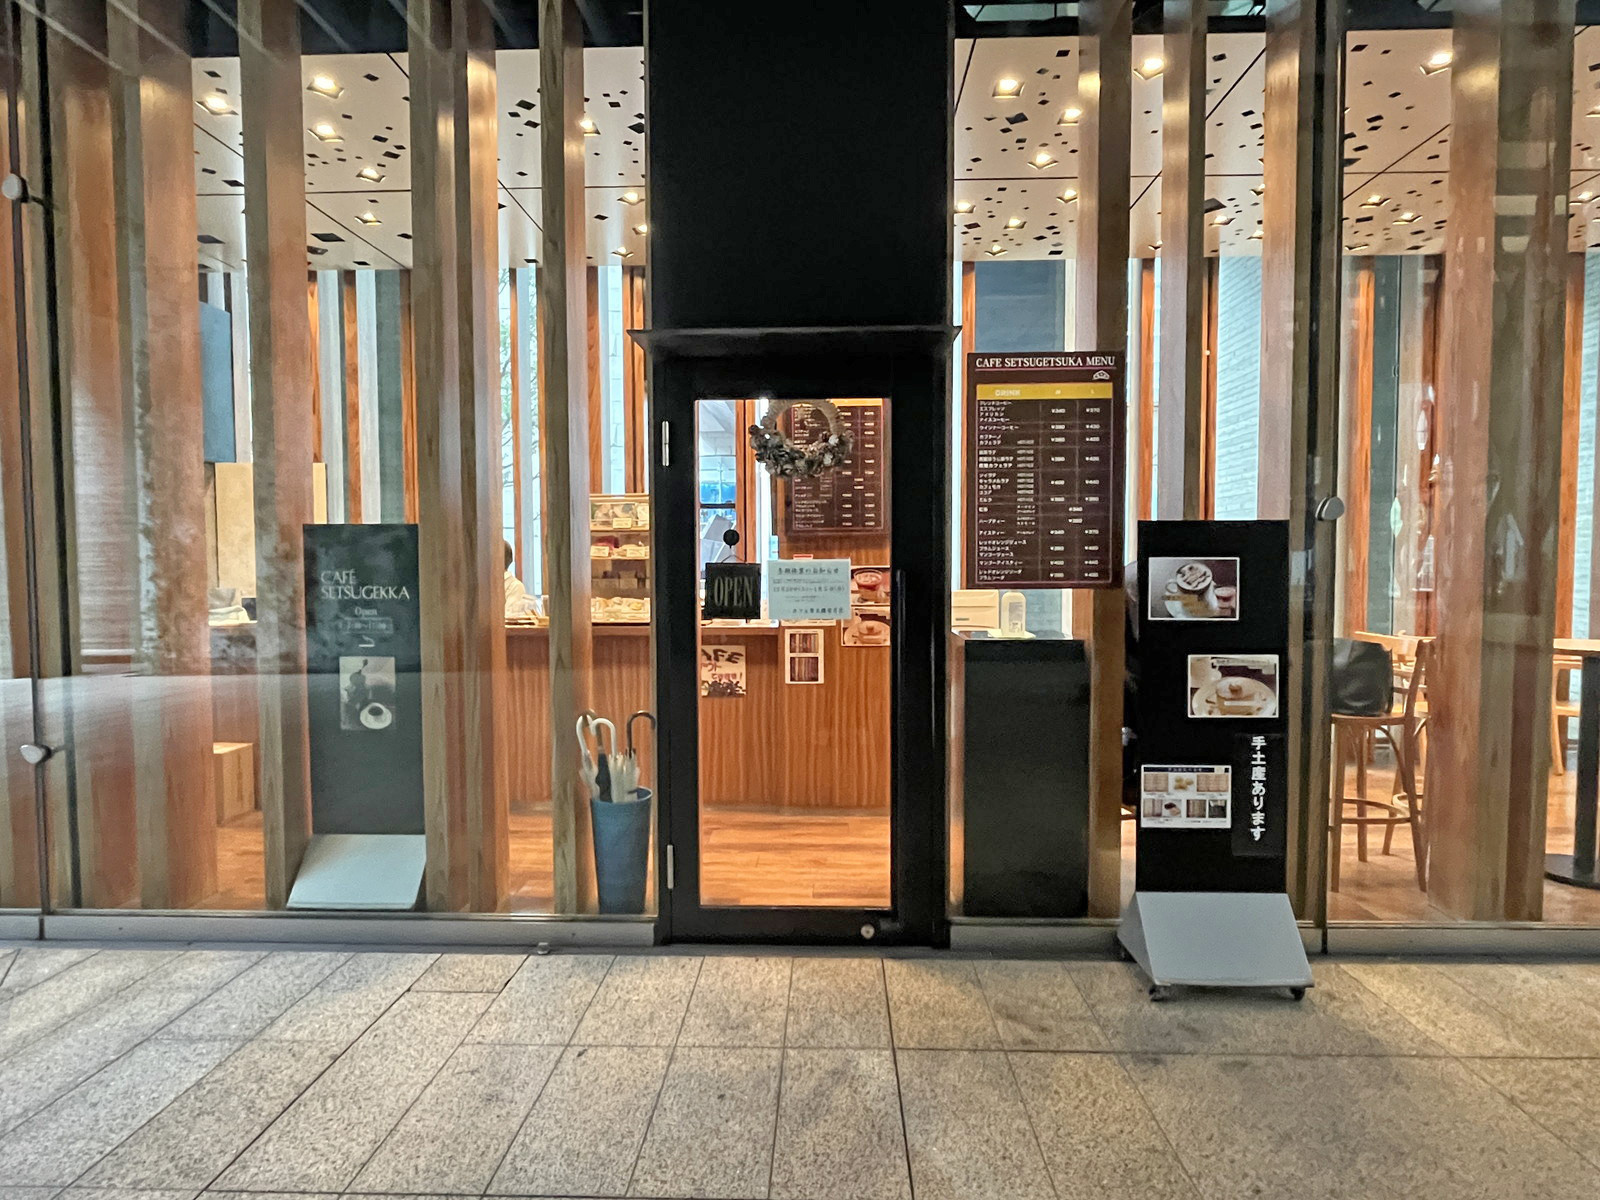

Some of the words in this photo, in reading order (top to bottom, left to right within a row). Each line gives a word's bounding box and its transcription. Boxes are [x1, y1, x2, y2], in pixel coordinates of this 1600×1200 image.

[976, 358, 1001, 367] CAFE
[1004, 357, 1082, 367] SETSUGETSUKA
[1086, 356, 1115, 366] MENU
[320, 586, 410, 600] SETSUGEKKA
[714, 575, 754, 608] OPEN
[354, 606, 378, 617] Open
[1250, 735, 1267, 841] 手土産あります
